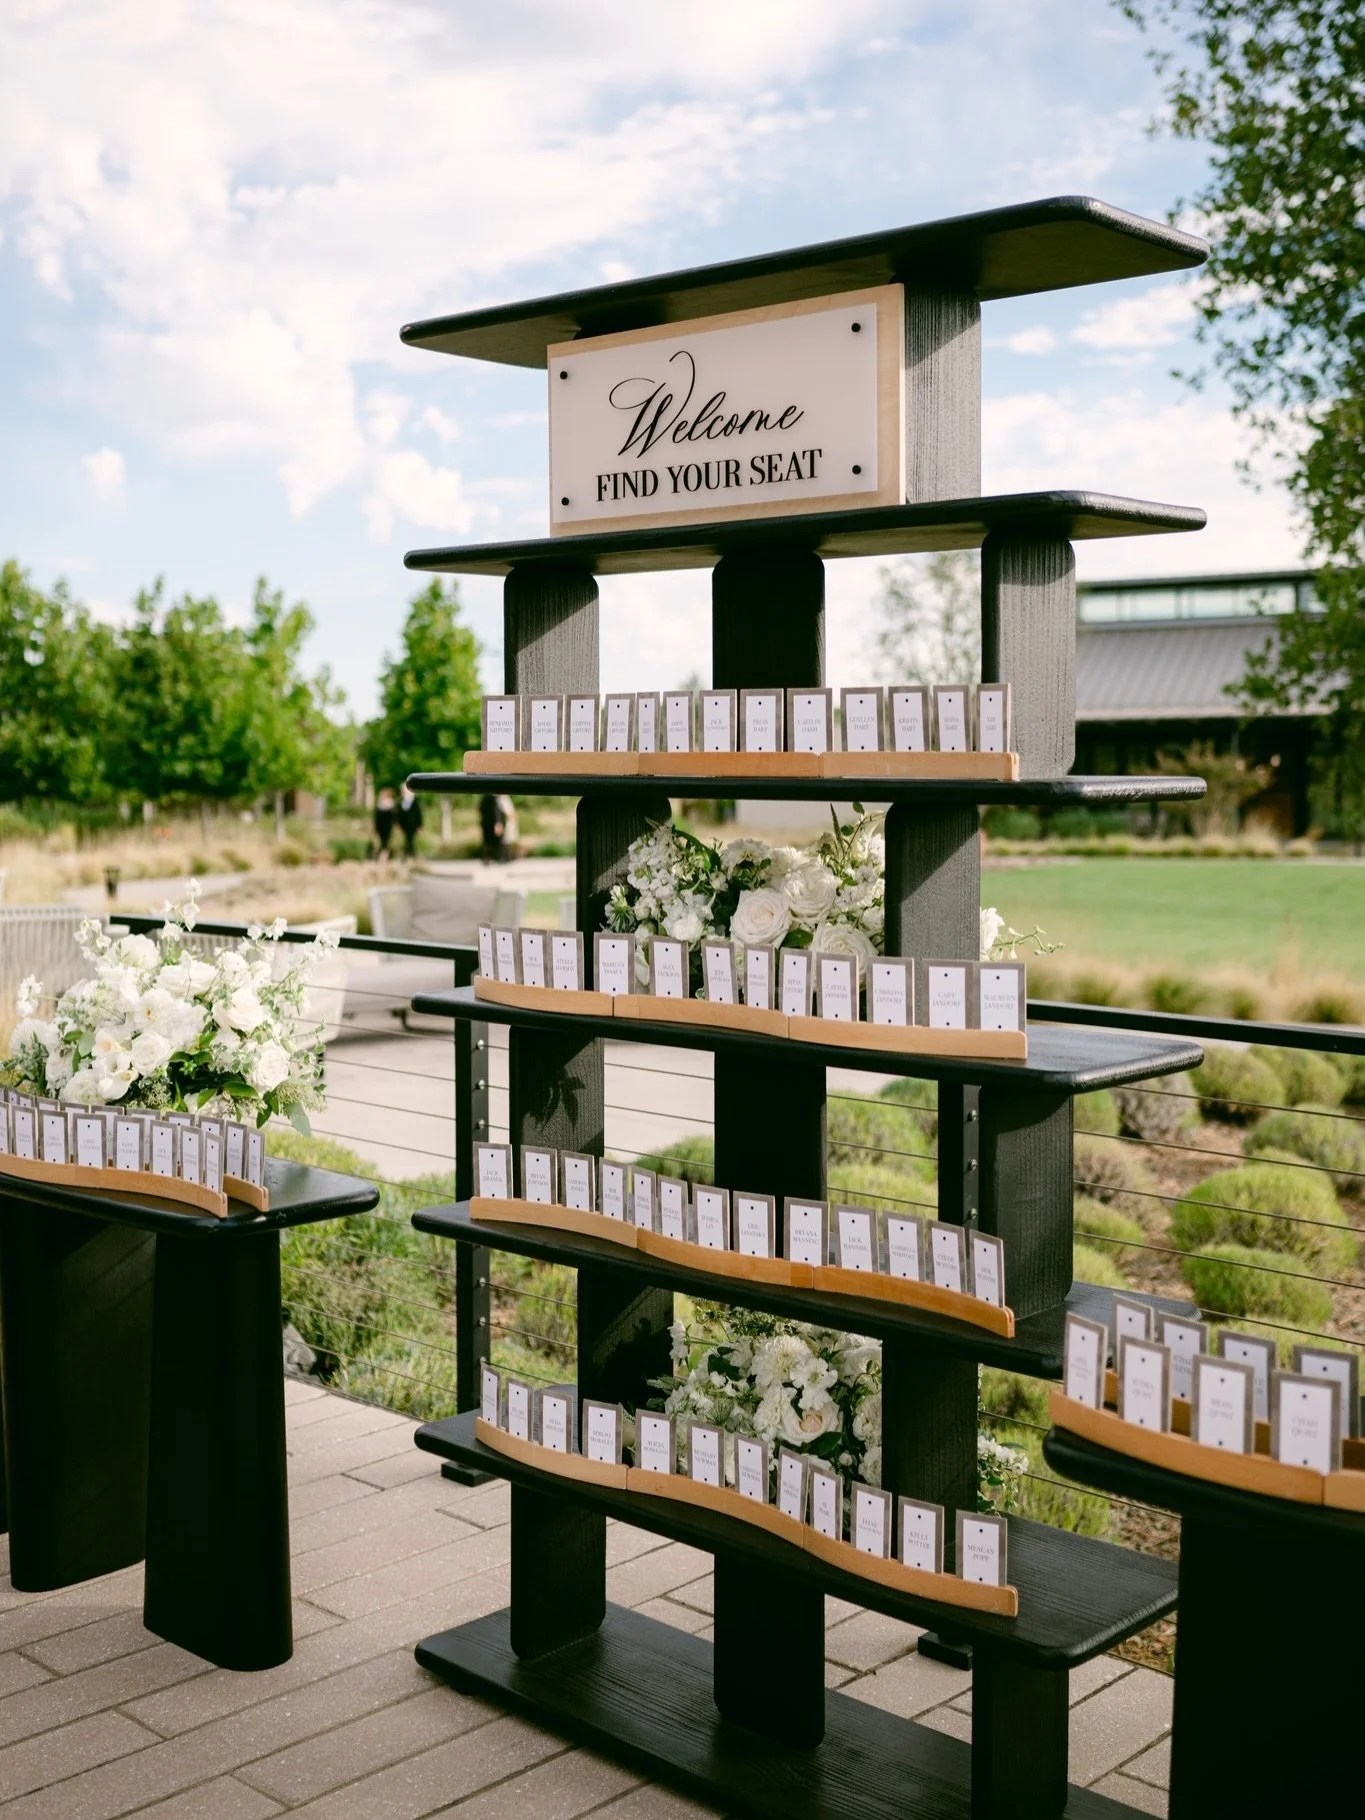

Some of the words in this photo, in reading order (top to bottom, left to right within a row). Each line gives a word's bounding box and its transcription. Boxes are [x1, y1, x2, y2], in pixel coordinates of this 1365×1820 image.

[609, 351, 804, 458] Welcome
[596, 468, 659, 502] FIND
[665, 458, 743, 494] YOUR
[749, 448, 823, 486] SEAT
